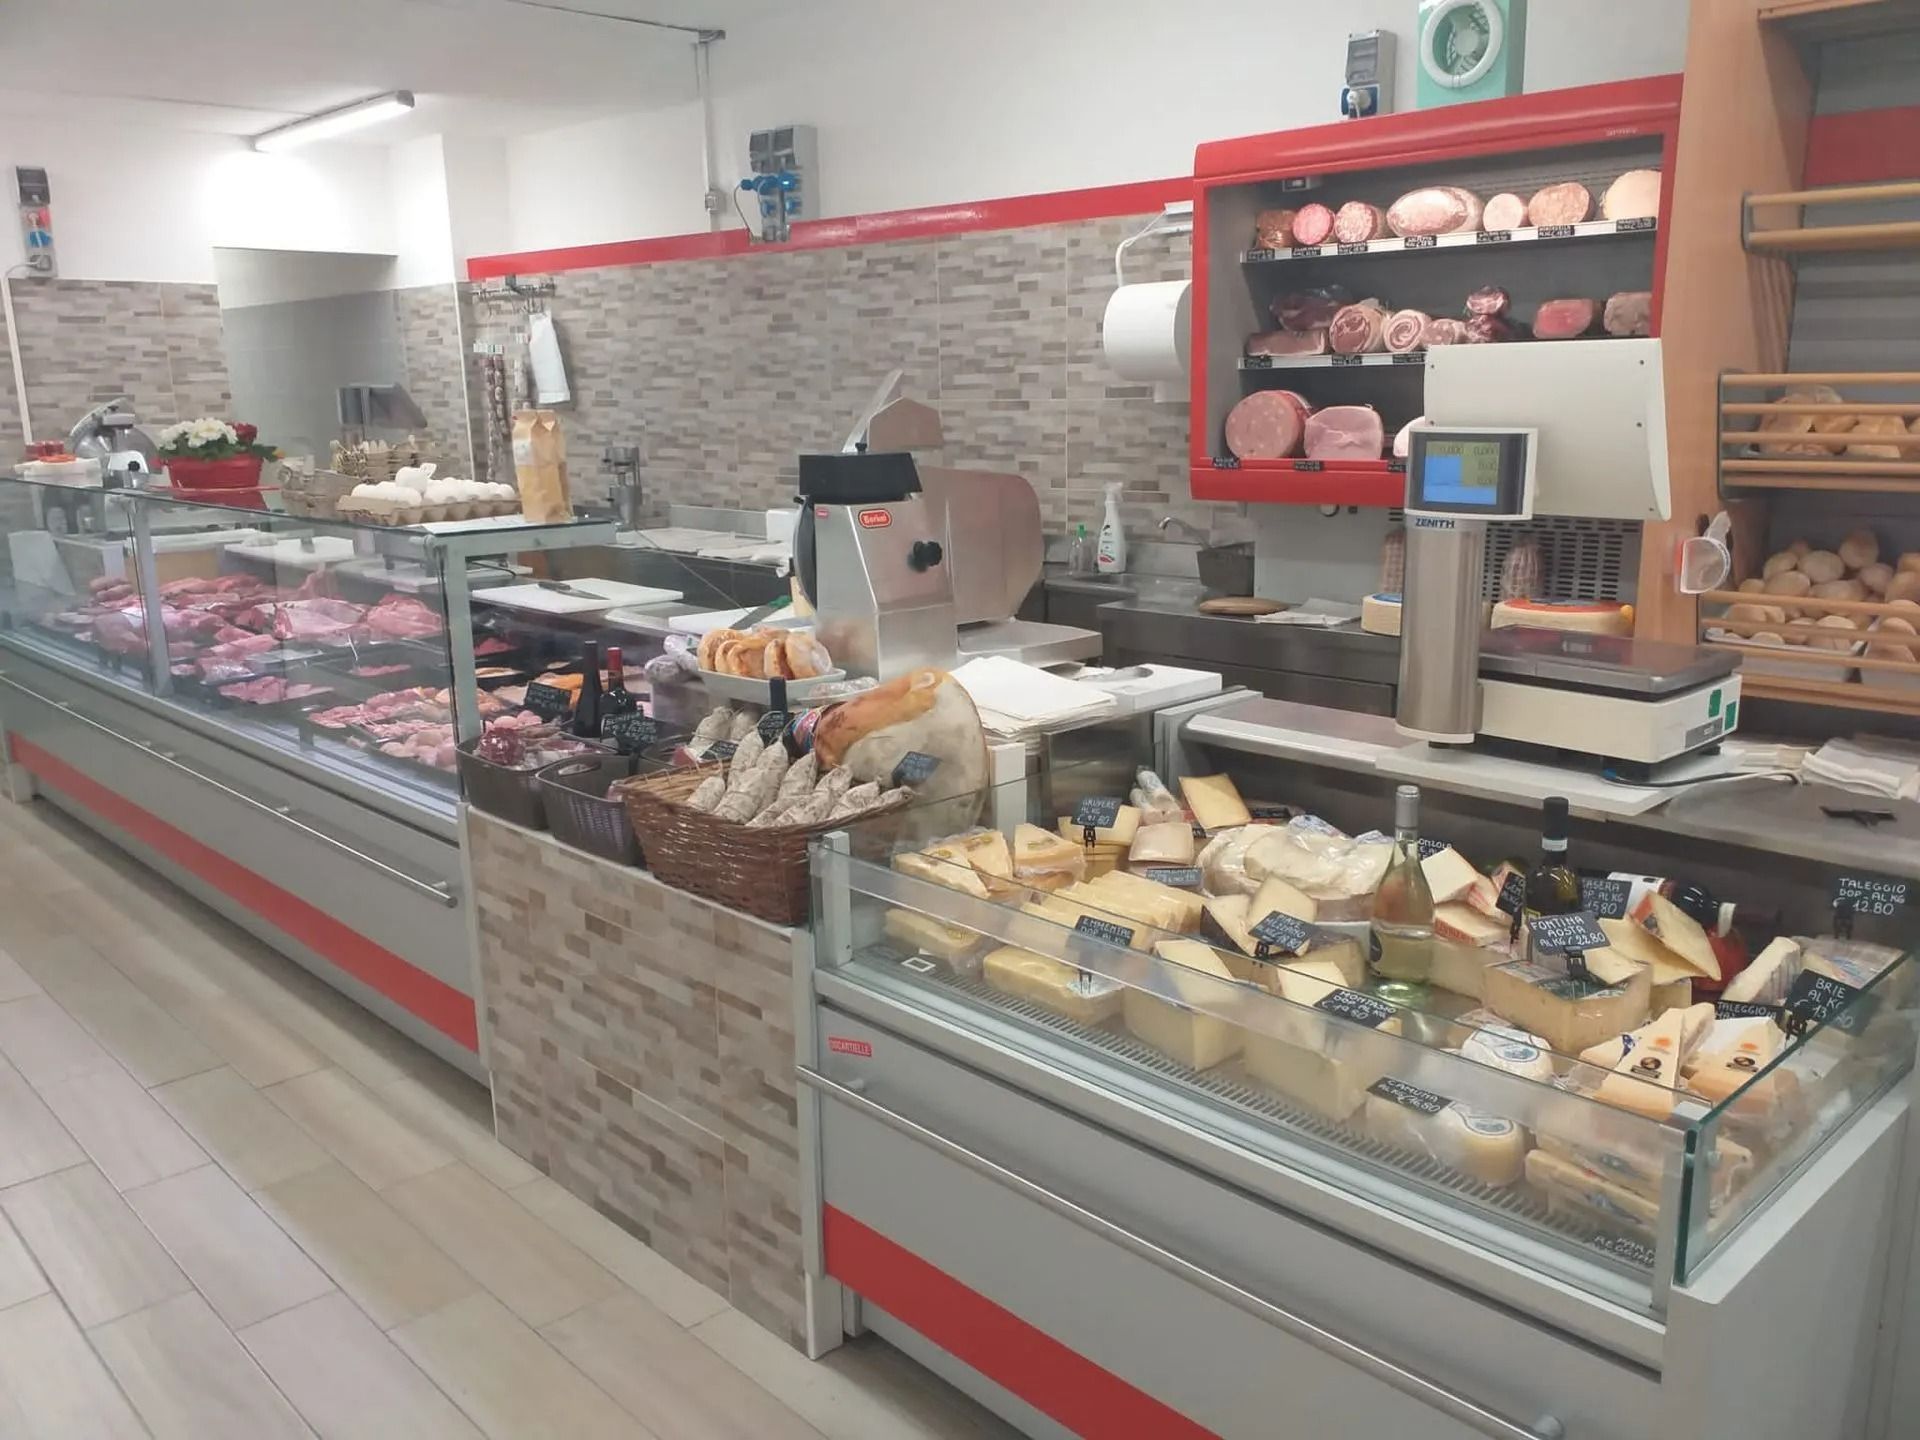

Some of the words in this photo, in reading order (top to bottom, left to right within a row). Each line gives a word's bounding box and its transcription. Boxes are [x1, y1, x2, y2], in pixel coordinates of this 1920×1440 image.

[1415, 518, 1455, 529] ZENITH
[1583, 880, 1620, 892] ASERA
[1838, 877, 1906, 894] TALEGGIO
[1839, 888, 1863, 898] DOP
[1871, 891, 1887, 902] AL
[1890, 894, 1906, 904] KG
[1530, 916, 1585, 931] FONTINA
[1547, 925, 1586, 938] AOSTA
[1808, 989, 1822, 1002] AL
[1815, 978, 1846, 999] BRIE
[1717, 1001, 1767, 1016] TALEGGIO
